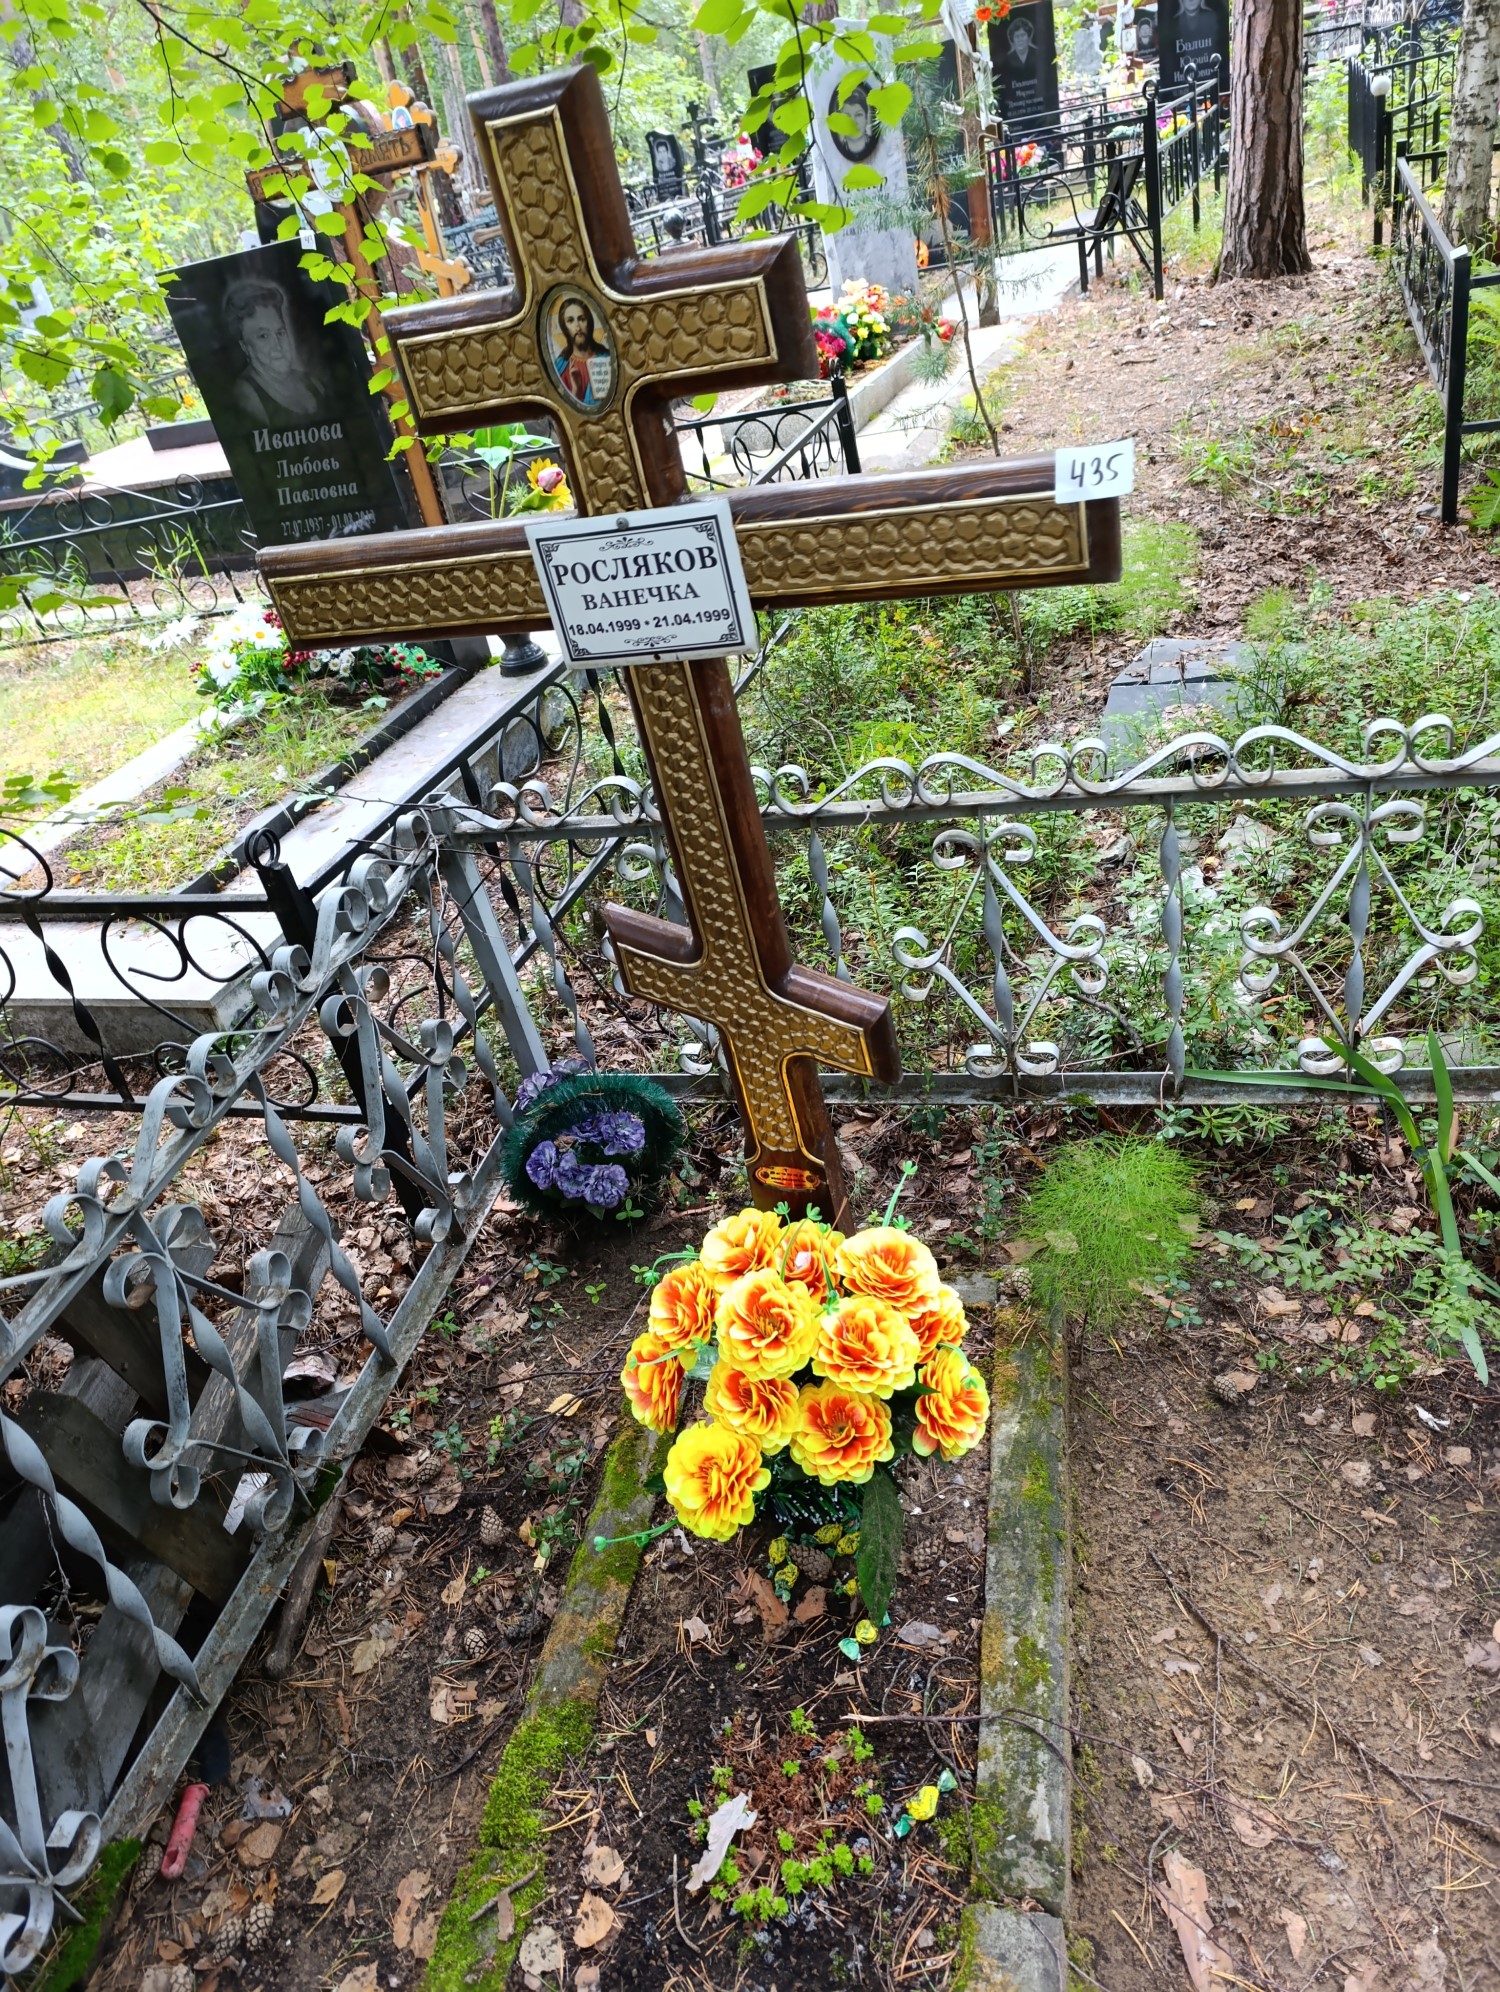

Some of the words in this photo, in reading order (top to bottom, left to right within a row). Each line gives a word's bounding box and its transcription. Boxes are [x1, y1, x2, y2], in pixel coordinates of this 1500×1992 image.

[252, 422, 344, 453] Иванова
[276, 456, 340, 479] Любовь
[1070, 452, 1125, 488] 435
[276, 482, 359, 506] Павловна
[551, 545, 718, 586] РОСЛЯКОВ
[581, 582, 701, 611] ВАНЕЧКА
[568, 618, 641, 637] 18.04.1999
[653, 608, 730, 628] 21.04.1999
